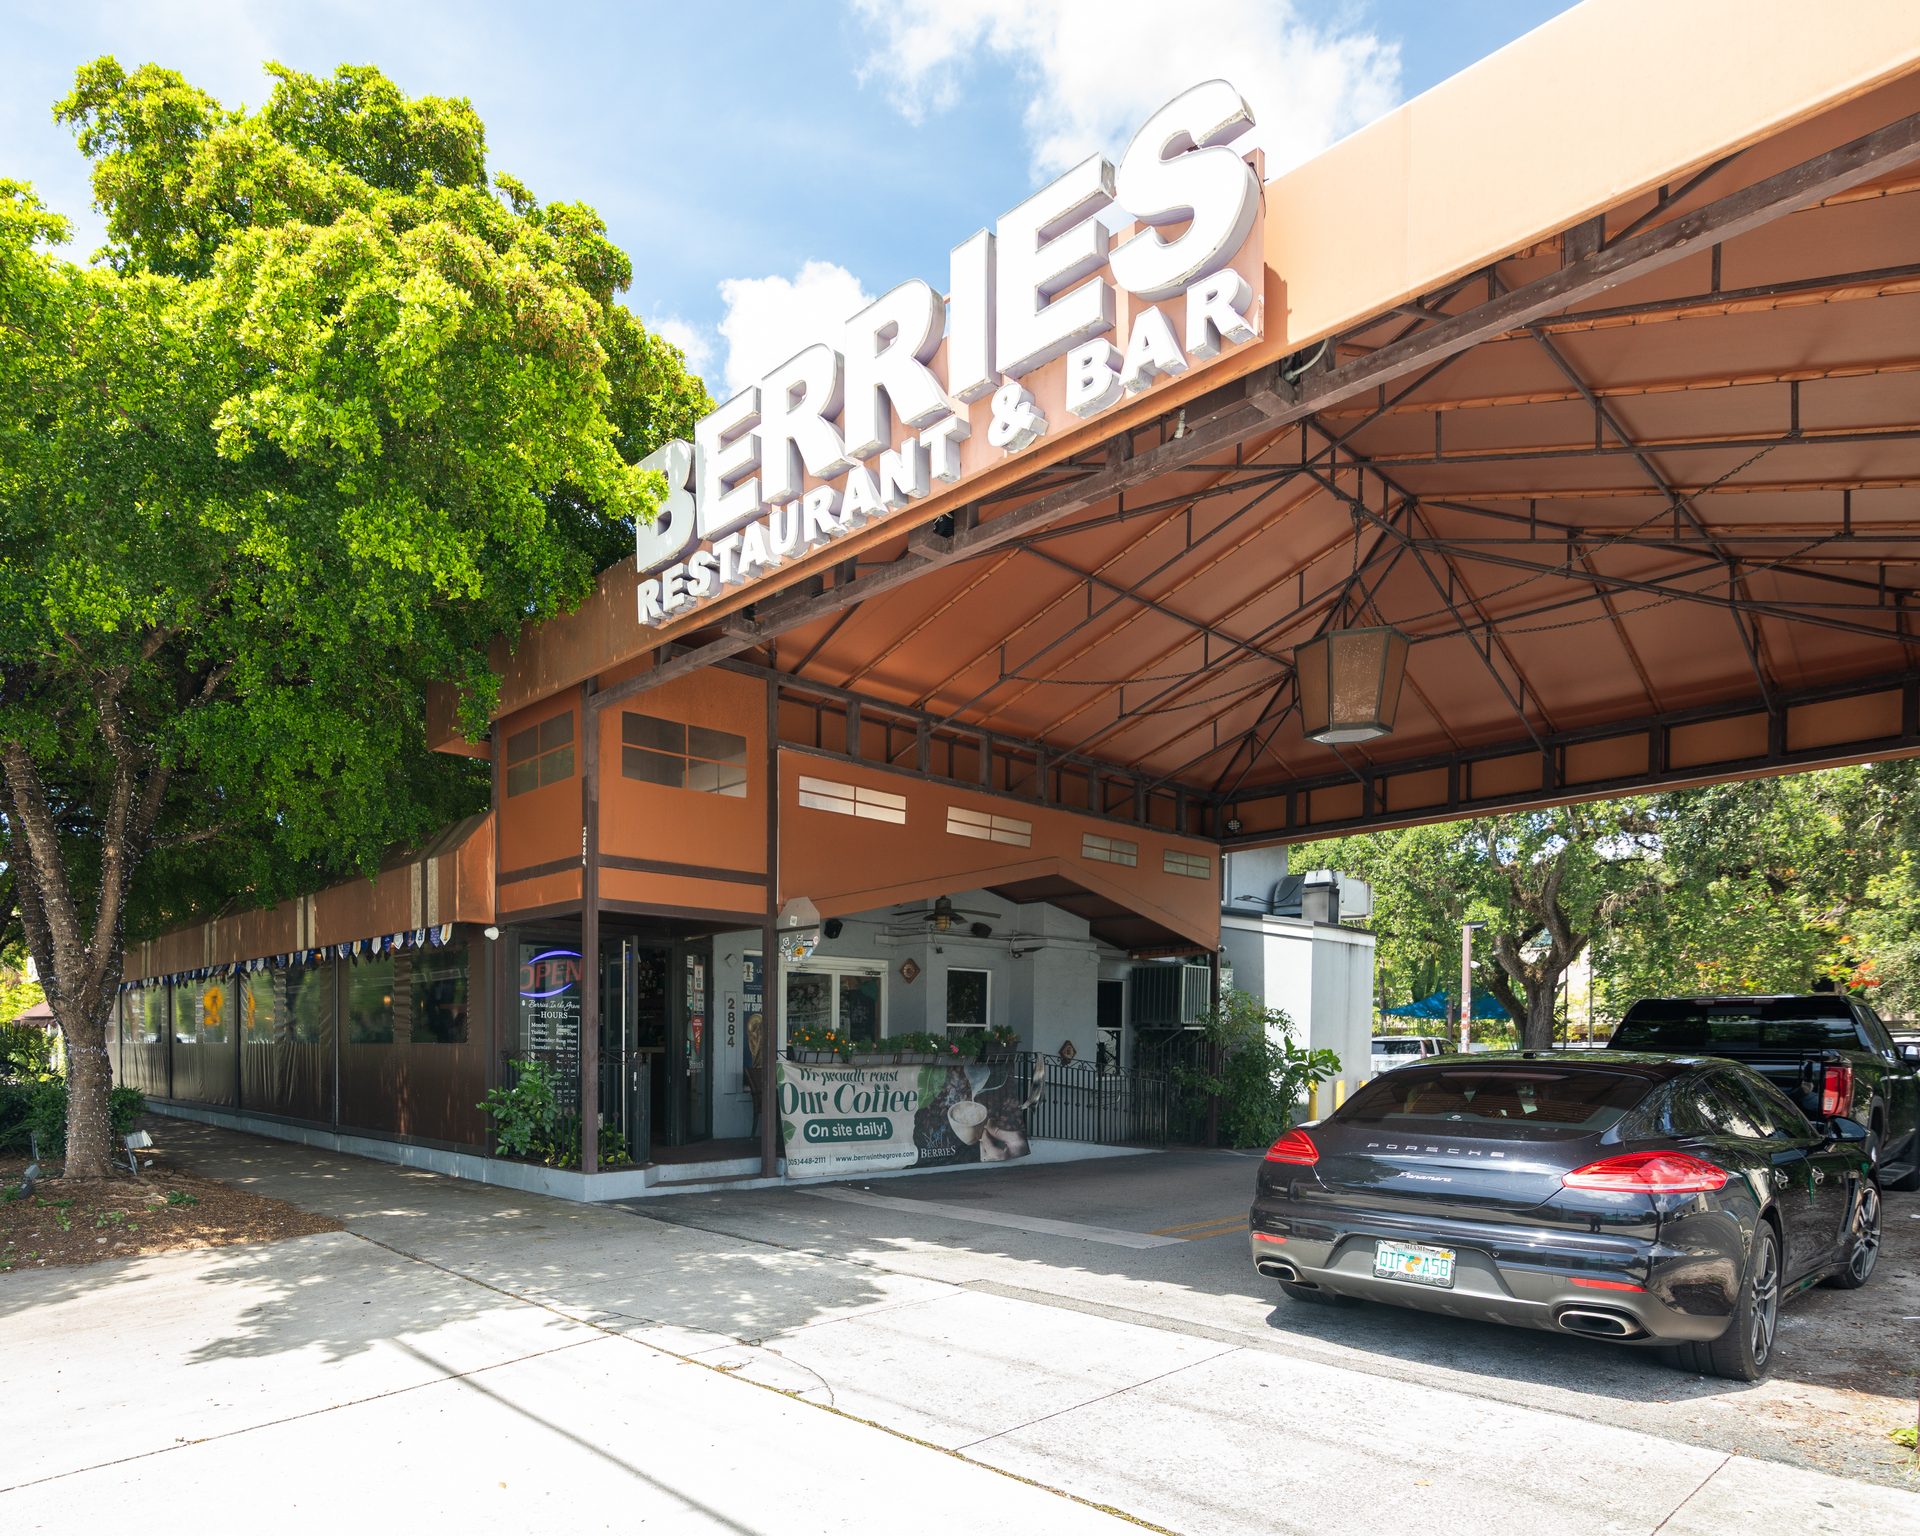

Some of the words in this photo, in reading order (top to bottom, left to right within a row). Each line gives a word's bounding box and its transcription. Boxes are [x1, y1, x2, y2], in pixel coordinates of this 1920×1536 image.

[636, 79, 1258, 576] BERRIES
[637, 413, 972, 629] RESTAURANT
[987, 382, 1048, 453] &
[1065, 268, 1254, 420] BAR
[520, 959, 584, 990] OPEN
[540, 1011, 568, 1019] HOURS
[727, 998, 735, 1048] 2884
[821, 1068, 865, 1086] proudly
[869, 1070, 899, 1082] roast
[780, 1082, 829, 1115] Our
[834, 1083, 918, 1114] Coffee
[808, 1124, 829, 1138] On
[832, 1122, 853, 1137] site
[856, 1120, 888, 1138] daily!
[921, 1145, 956, 1159] BERRIES
[1367, 1142, 1505, 1158] PORSCHE
[1397, 1171, 1452, 1183] Panamera
